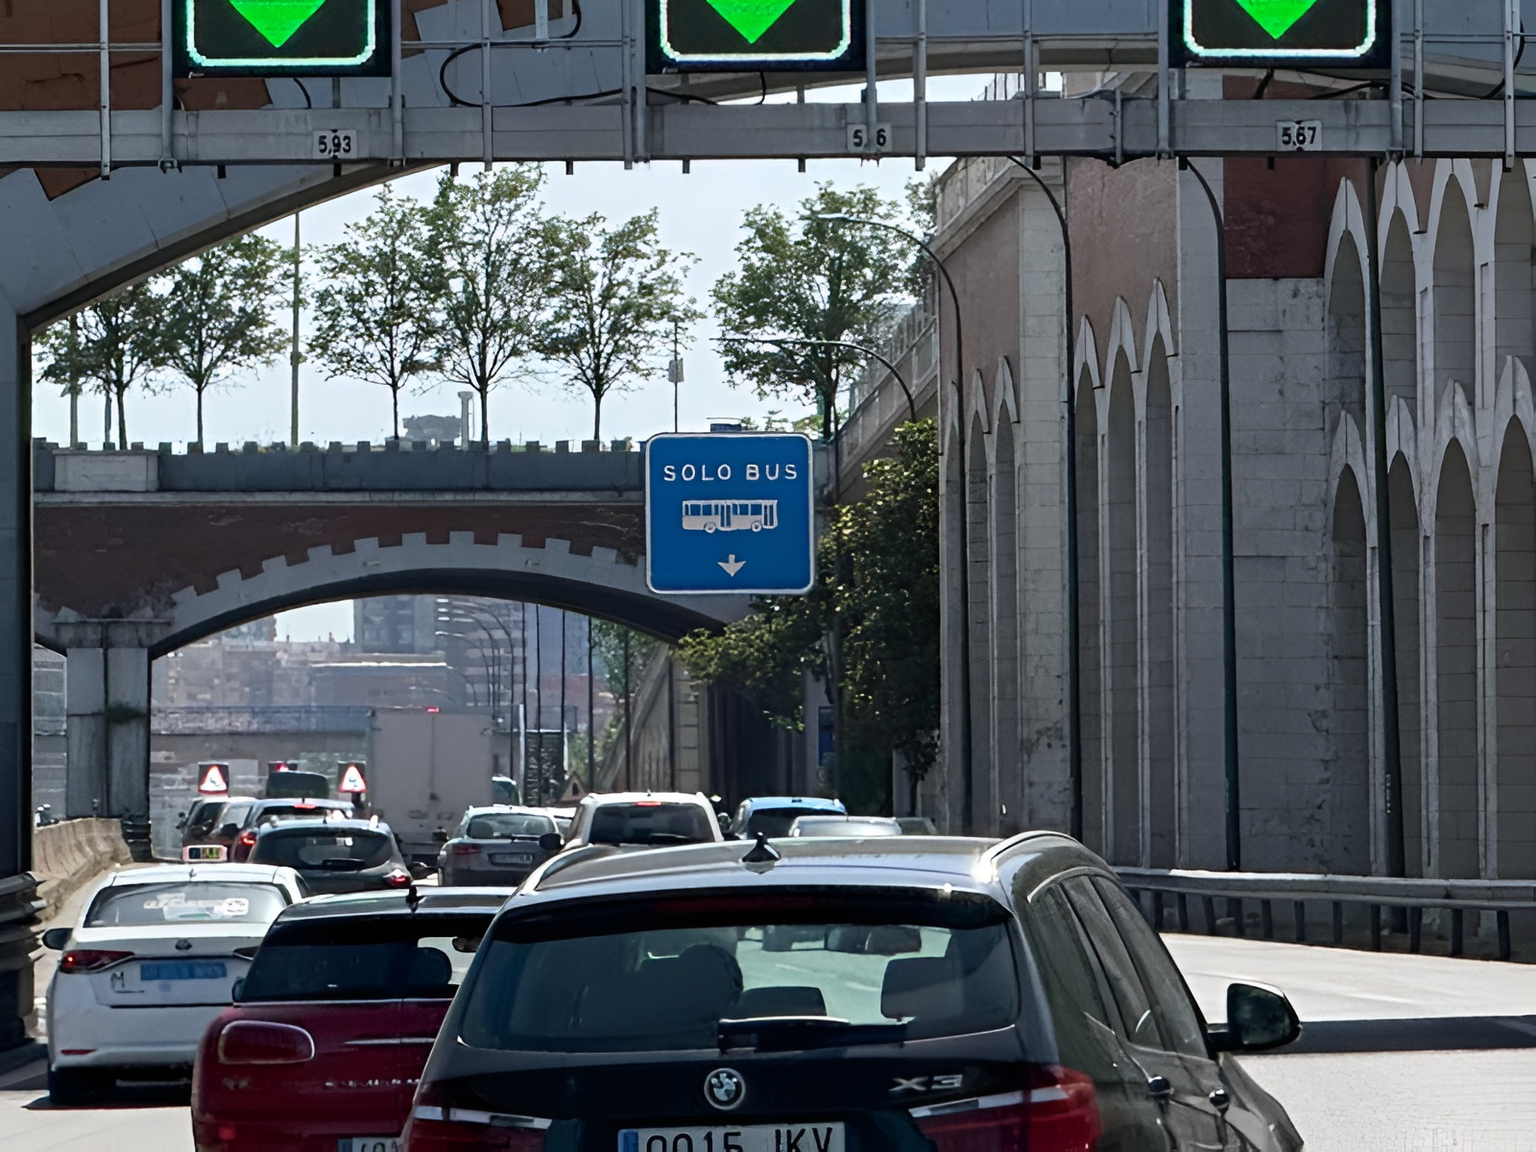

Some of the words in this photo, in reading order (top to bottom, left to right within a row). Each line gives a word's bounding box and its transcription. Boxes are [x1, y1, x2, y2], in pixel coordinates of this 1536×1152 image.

[663, 464, 732, 482] SOLO
[746, 463, 798, 481] BUS
[888, 1074, 963, 1091] X3
